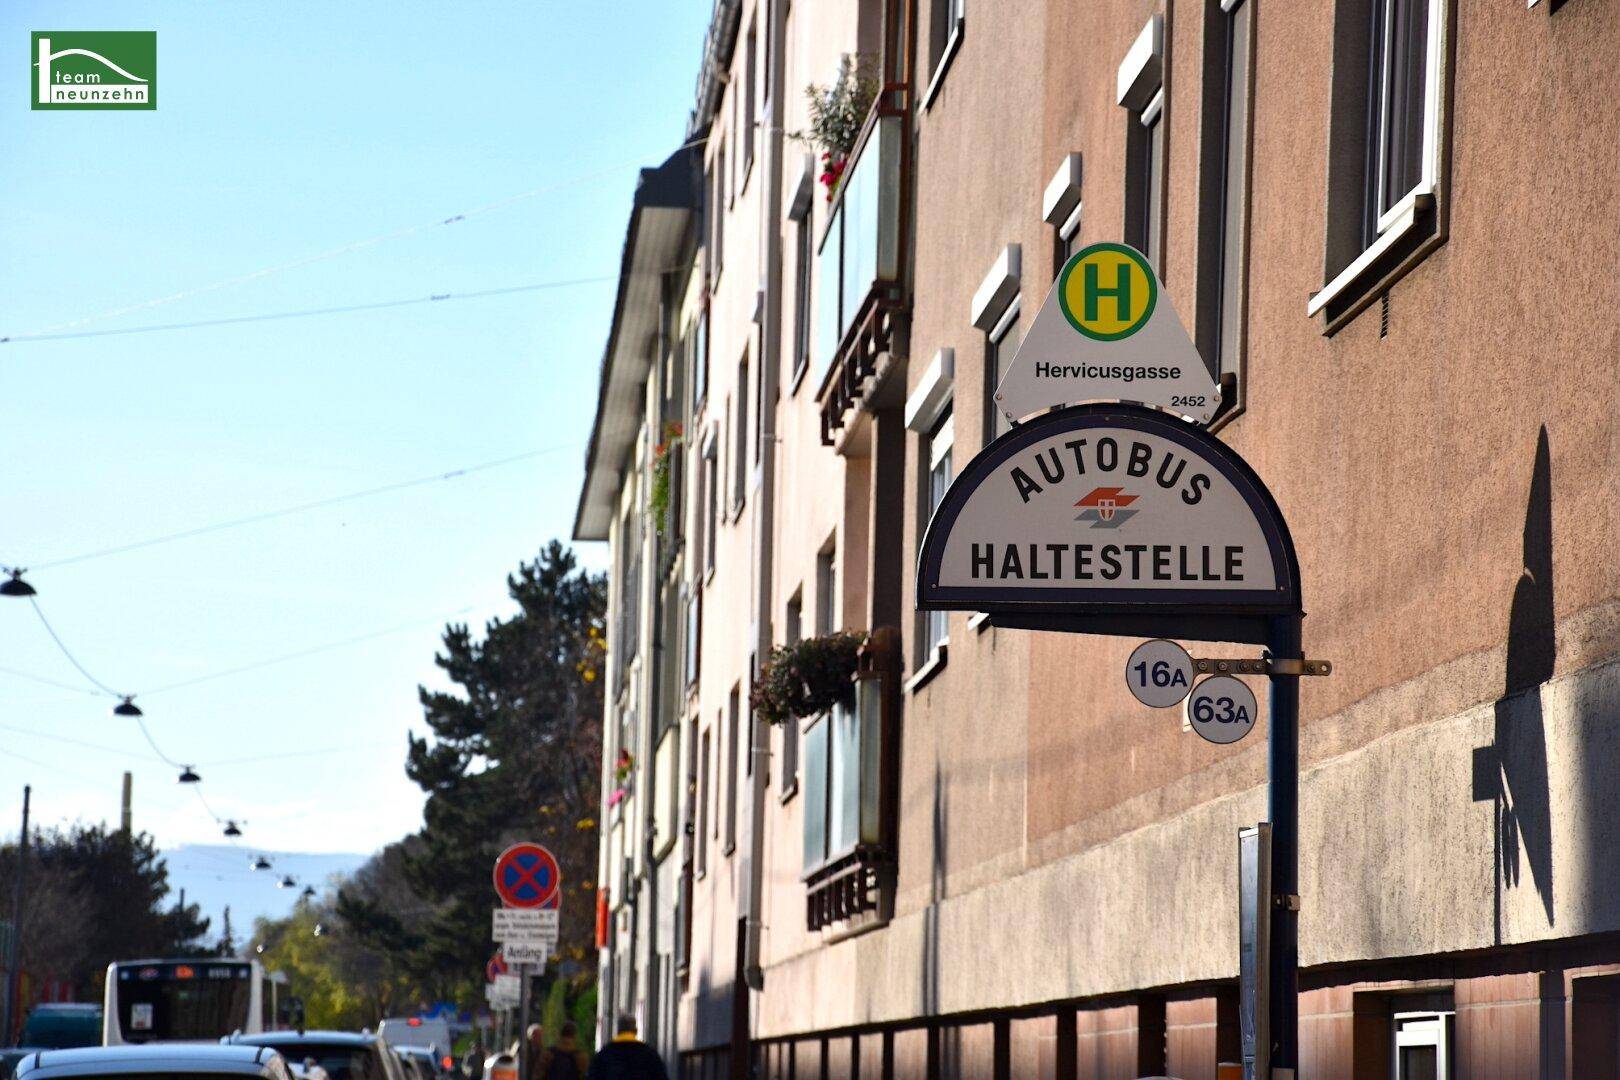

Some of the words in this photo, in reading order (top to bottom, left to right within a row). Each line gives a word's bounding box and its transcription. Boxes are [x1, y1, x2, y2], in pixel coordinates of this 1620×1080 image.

[1084, 263, 1131, 322] H
[1035, 362, 1181, 382] Hervicusgasse
[1171, 396, 1206, 407] 2452
[1010, 437, 1211, 505] AUTOBUS
[971, 543, 1245, 581] HALTESTELLE
[1134, 661, 1188, 687] 16A
[1193, 696, 1250, 724] 63A
